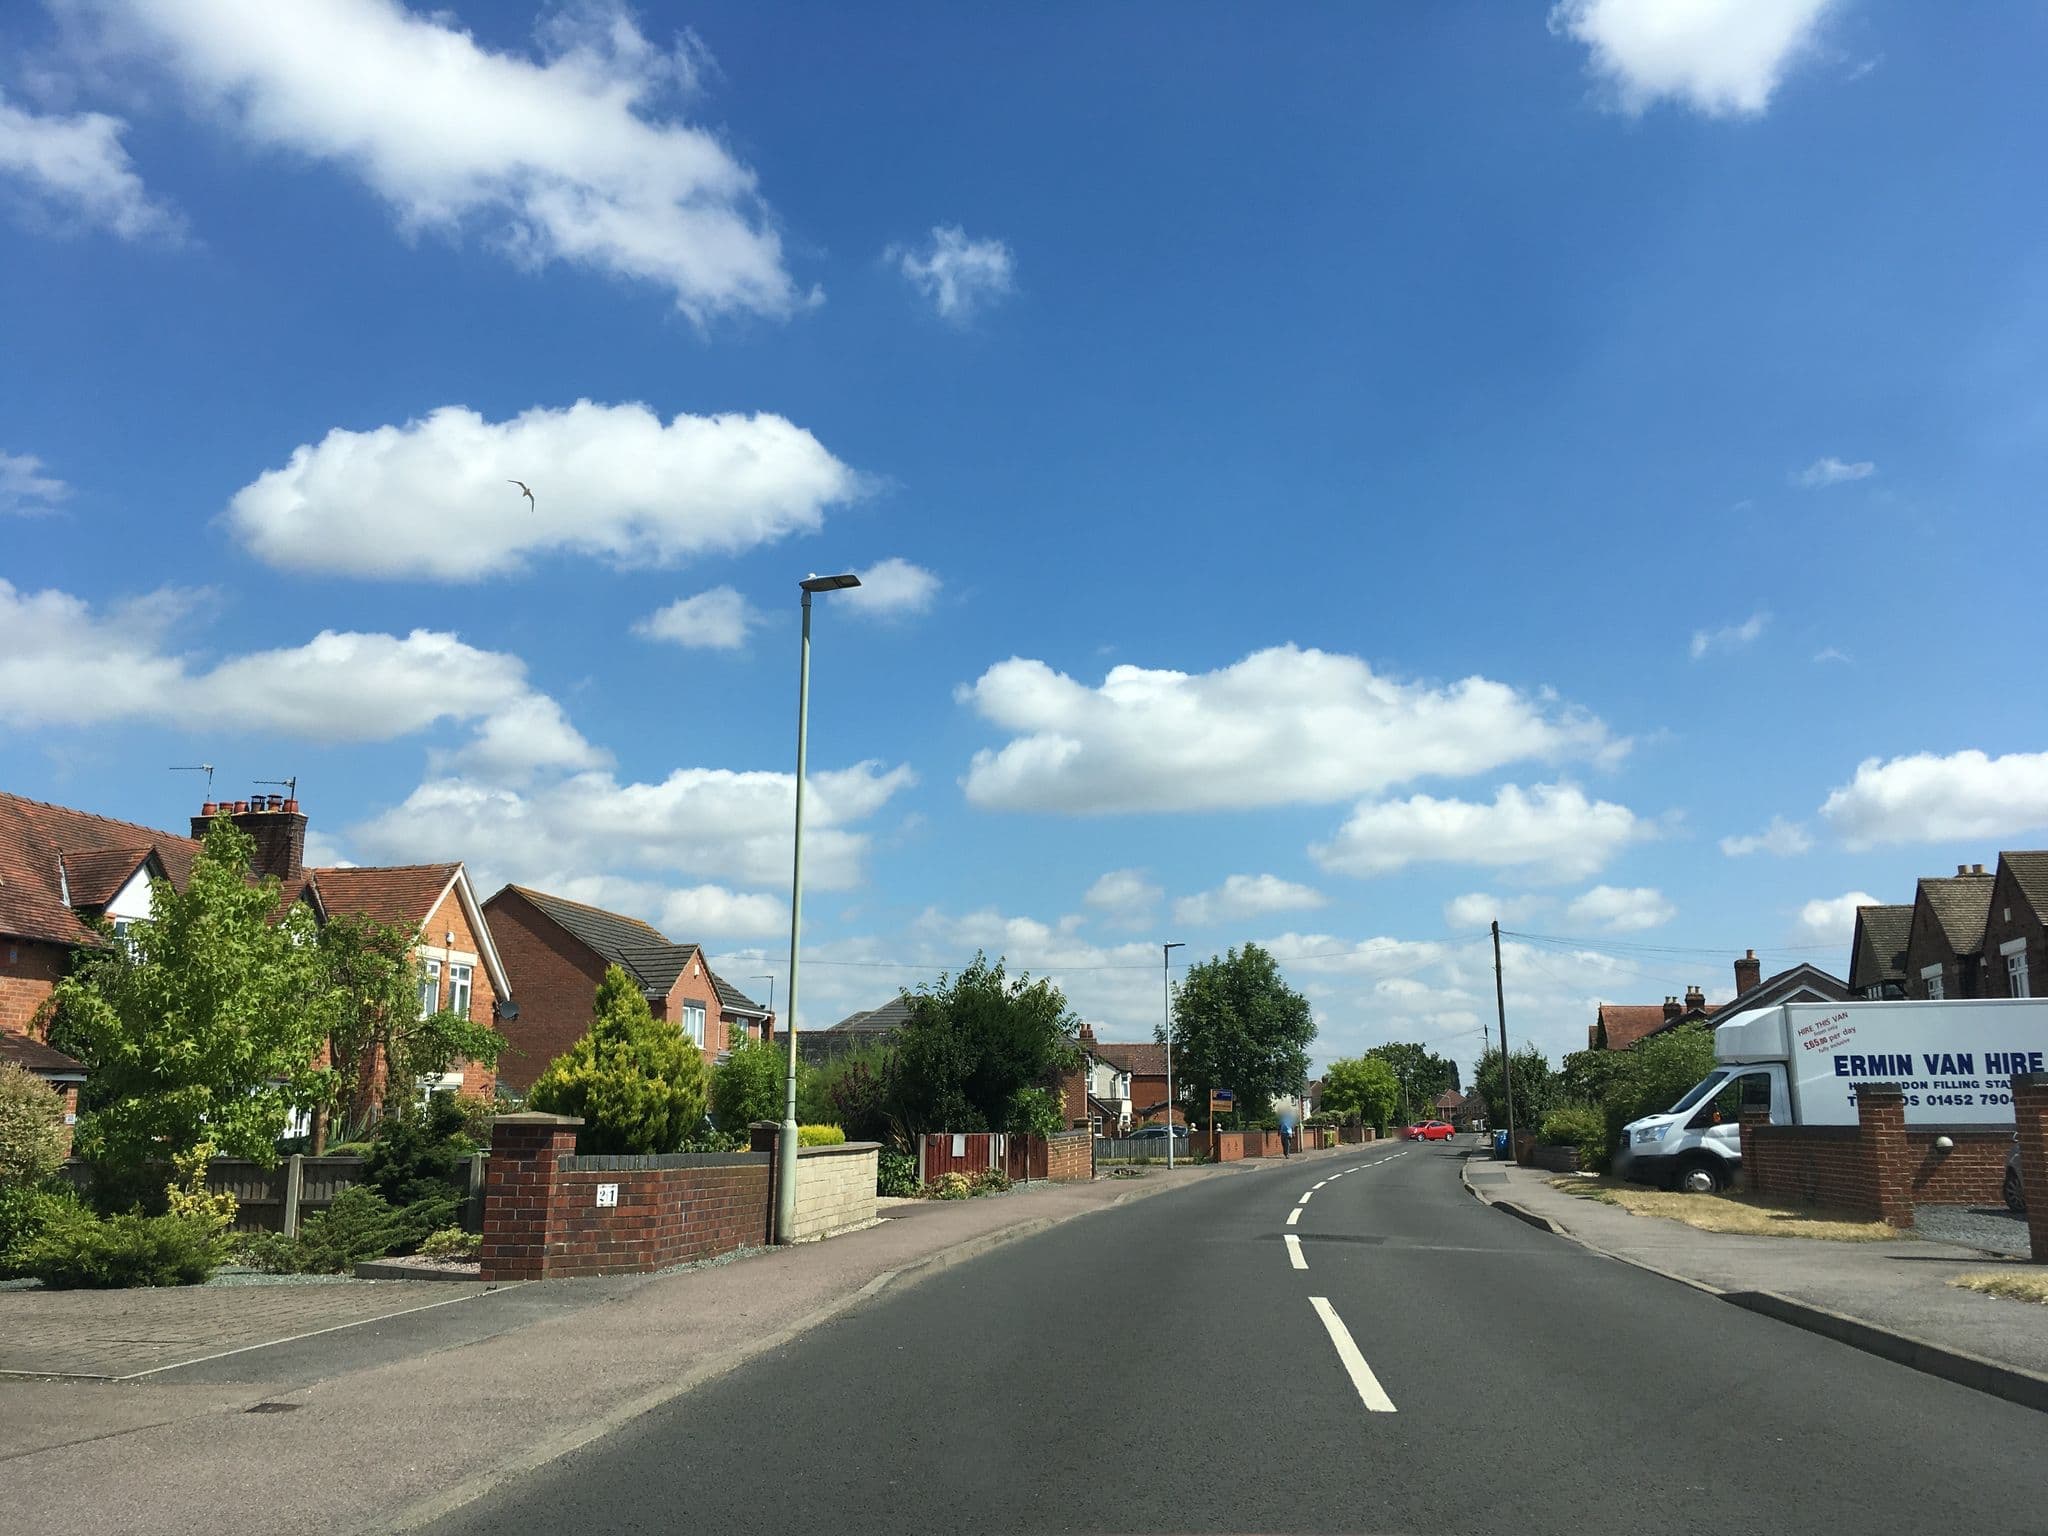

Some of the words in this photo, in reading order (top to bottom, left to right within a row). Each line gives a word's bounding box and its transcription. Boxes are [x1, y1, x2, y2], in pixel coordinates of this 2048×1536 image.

[1797, 1024, 1814, 1037] HIRE
[1815, 1018, 1831, 1029] THIS
[1832, 1011, 1849, 1023] VAN
[1842, 1026, 1857, 1036] day
[1834, 1054, 1914, 1076] ERMIN
[1923, 1053, 1975, 1075] VAN
[1985, 1052, 2045, 1074] HIRE
[1934, 1080, 1980, 1089] FILLING
[1926, 1094, 1974, 1106] 01452
[599, 1190, 615, 1202] 21
